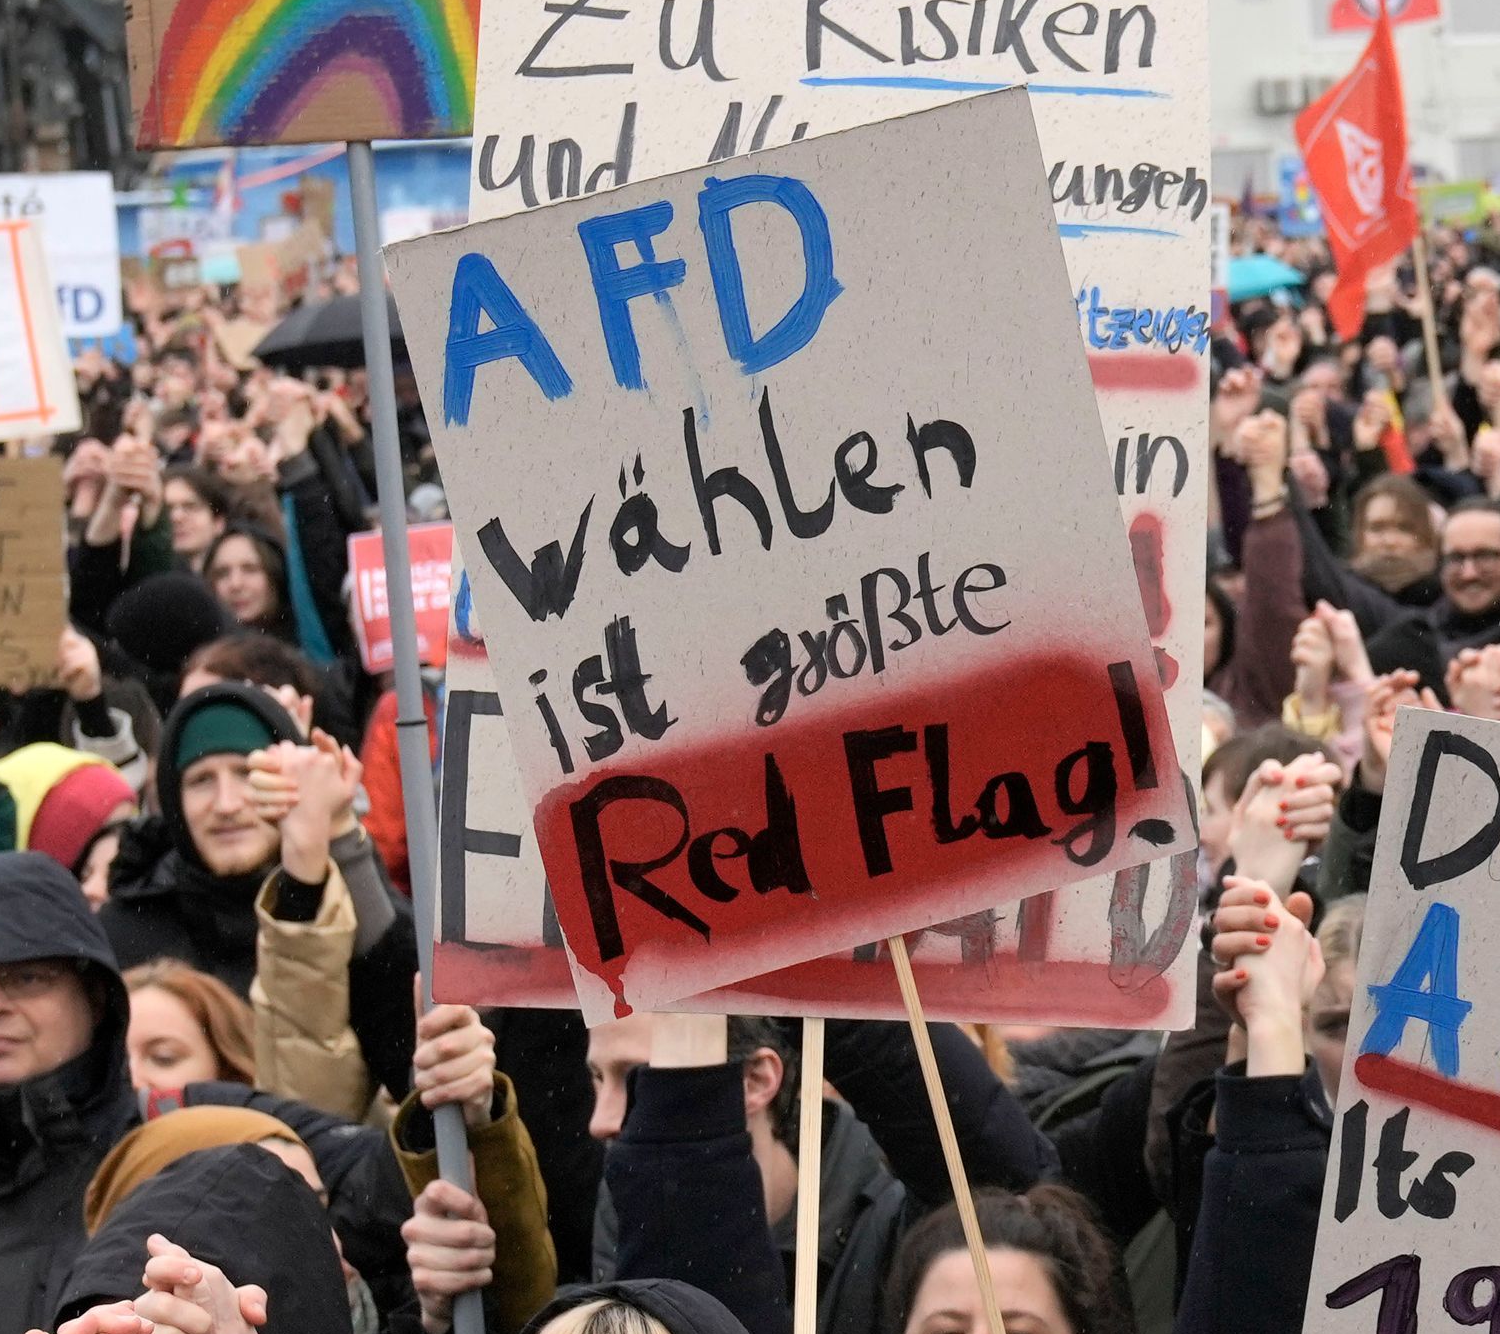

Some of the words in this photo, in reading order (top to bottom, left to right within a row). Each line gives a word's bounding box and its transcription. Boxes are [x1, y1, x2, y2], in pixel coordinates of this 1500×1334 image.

[478, 101, 637, 207] und
[1047, 160, 1210, 222] ungen
[443, 172, 845, 429] AFD
[529, 613, 678, 774] ist
[740, 551, 1014, 727] größte
[570, 751, 818, 963] Red
[843, 660, 1176, 876] Flag!
[1333, 1097, 1475, 1224] Its
